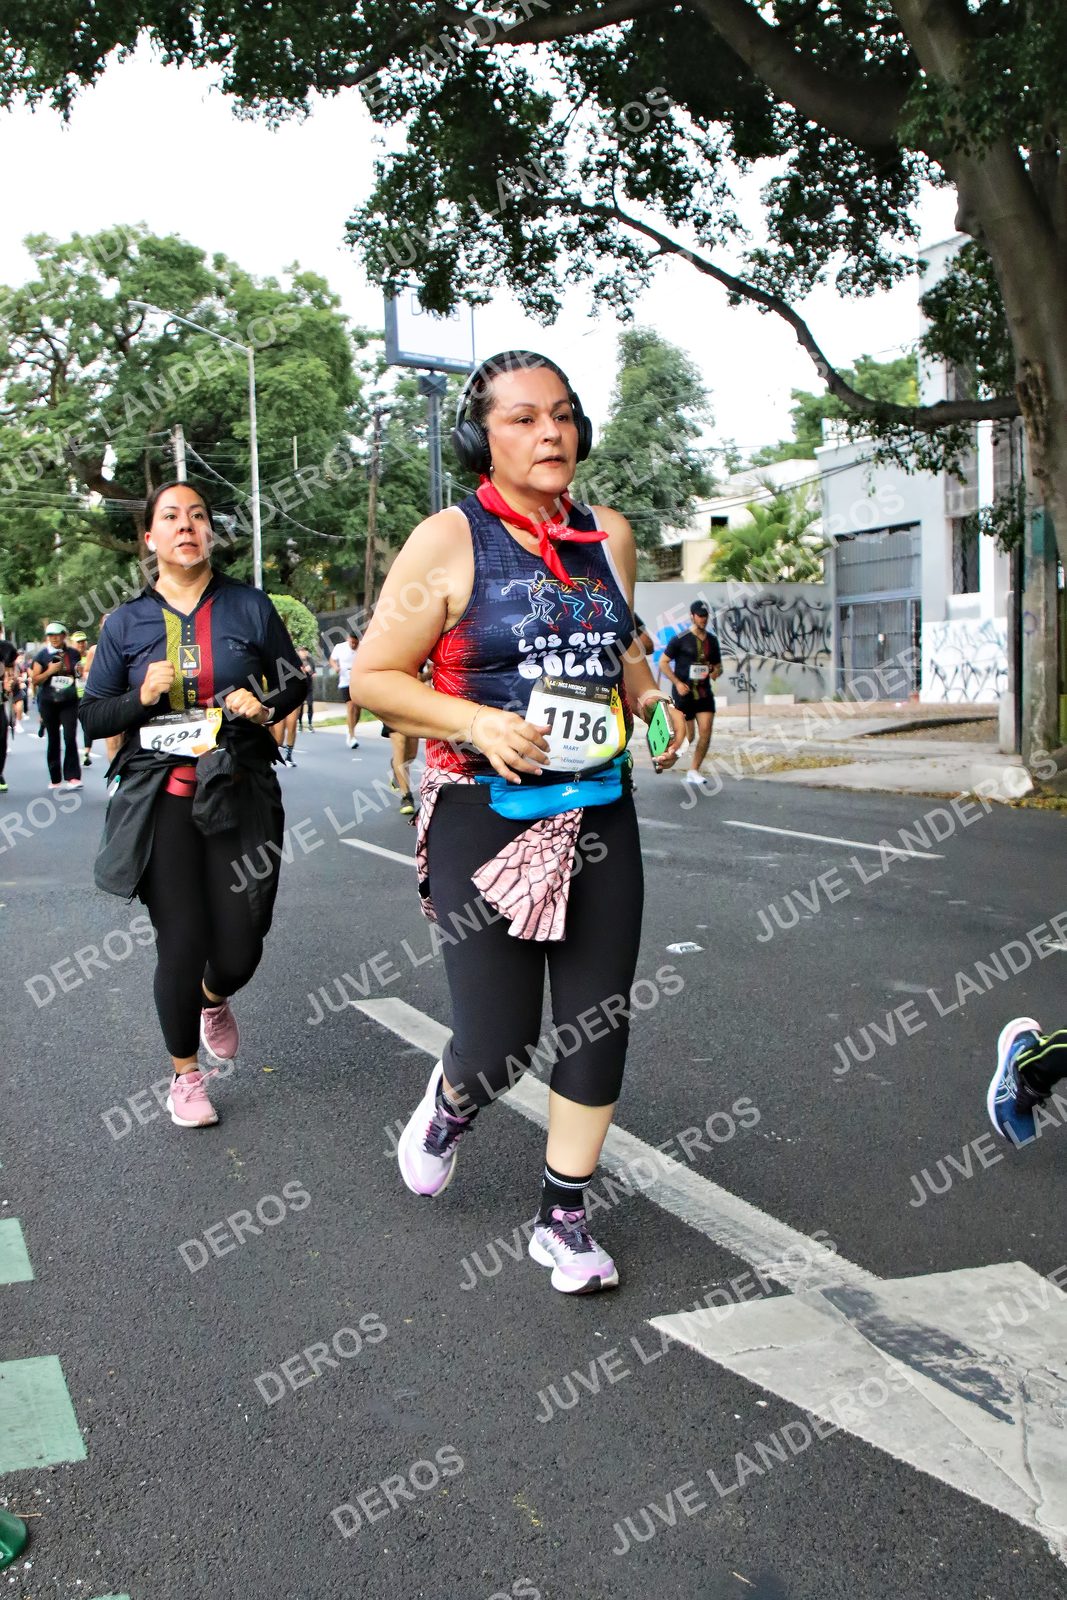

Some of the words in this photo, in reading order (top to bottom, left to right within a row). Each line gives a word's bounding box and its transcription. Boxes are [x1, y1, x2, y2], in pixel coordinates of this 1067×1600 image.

[518, 634, 561, 652] LOS
[568, 632, 617, 649] QUE
[543, 706, 608, 745] 1136
[151, 727, 202, 751] 6694
[562, 744, 580, 752] MARY
